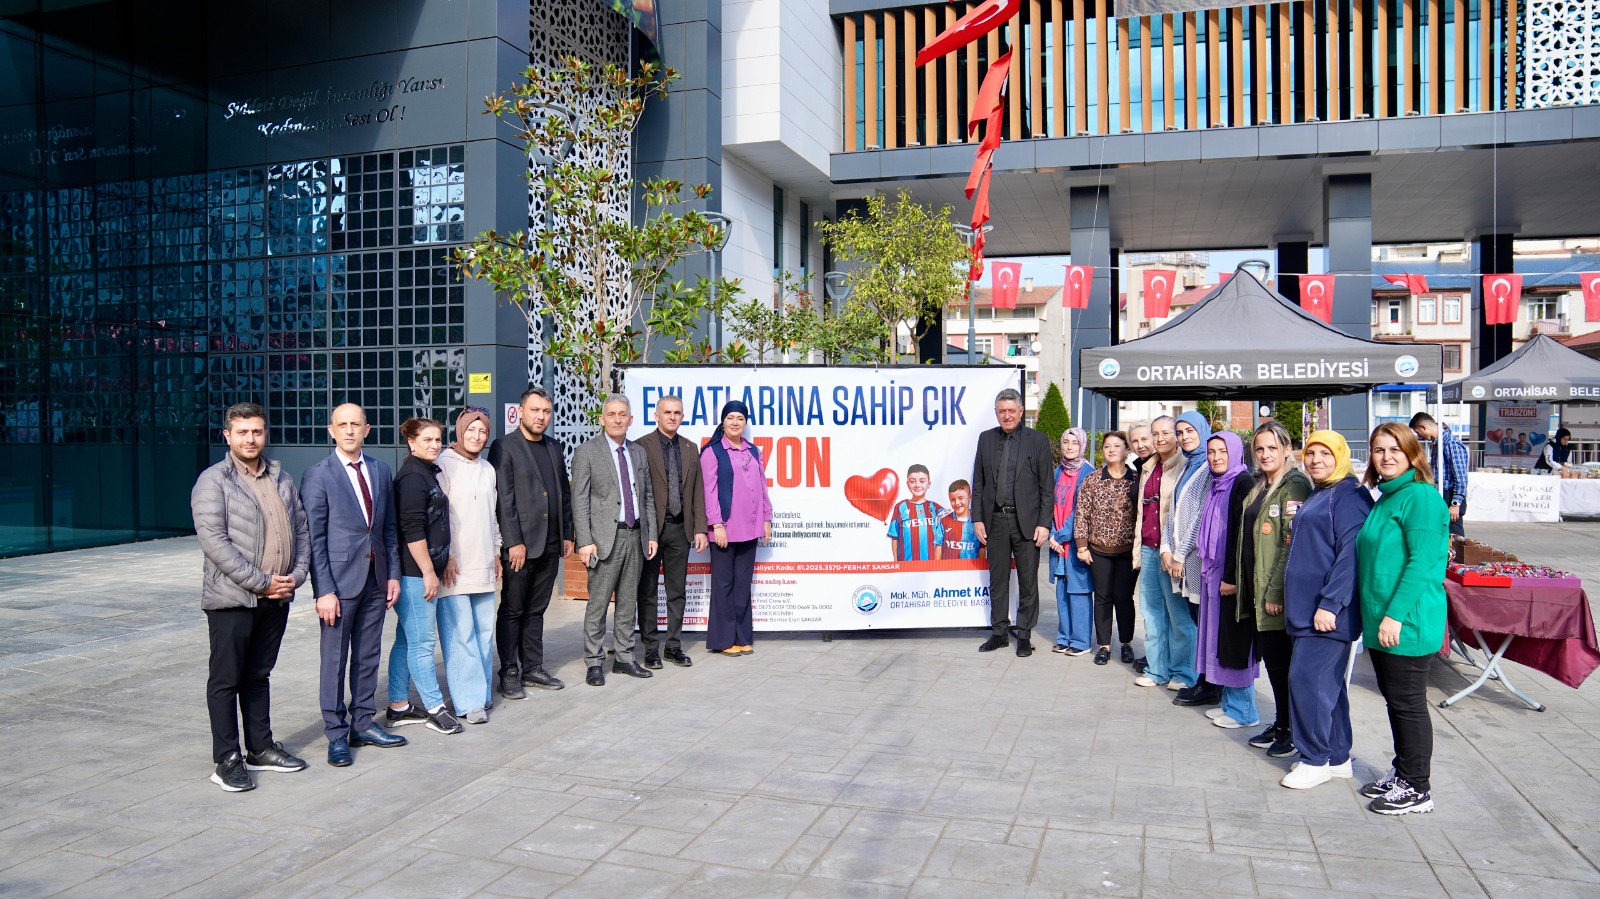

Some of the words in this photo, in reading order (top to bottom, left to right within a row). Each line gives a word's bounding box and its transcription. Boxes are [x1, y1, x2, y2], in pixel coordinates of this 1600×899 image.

[342, 108, 372, 126] Sesi
[375, 105, 398, 123] Ol
[1136, 360, 1242, 380] ORTAHİSAR
[1257, 358, 1369, 379] BELEDİYESİ
[1494, 385, 1557, 397] ORTAHİSAR
[833, 380, 913, 426] SAHİP
[922, 385, 967, 430] ÇIK
[1500, 408, 1536, 417] TRABZON!
[911, 590, 931, 599] Müh.
[933, 587, 971, 598] Ahmet
